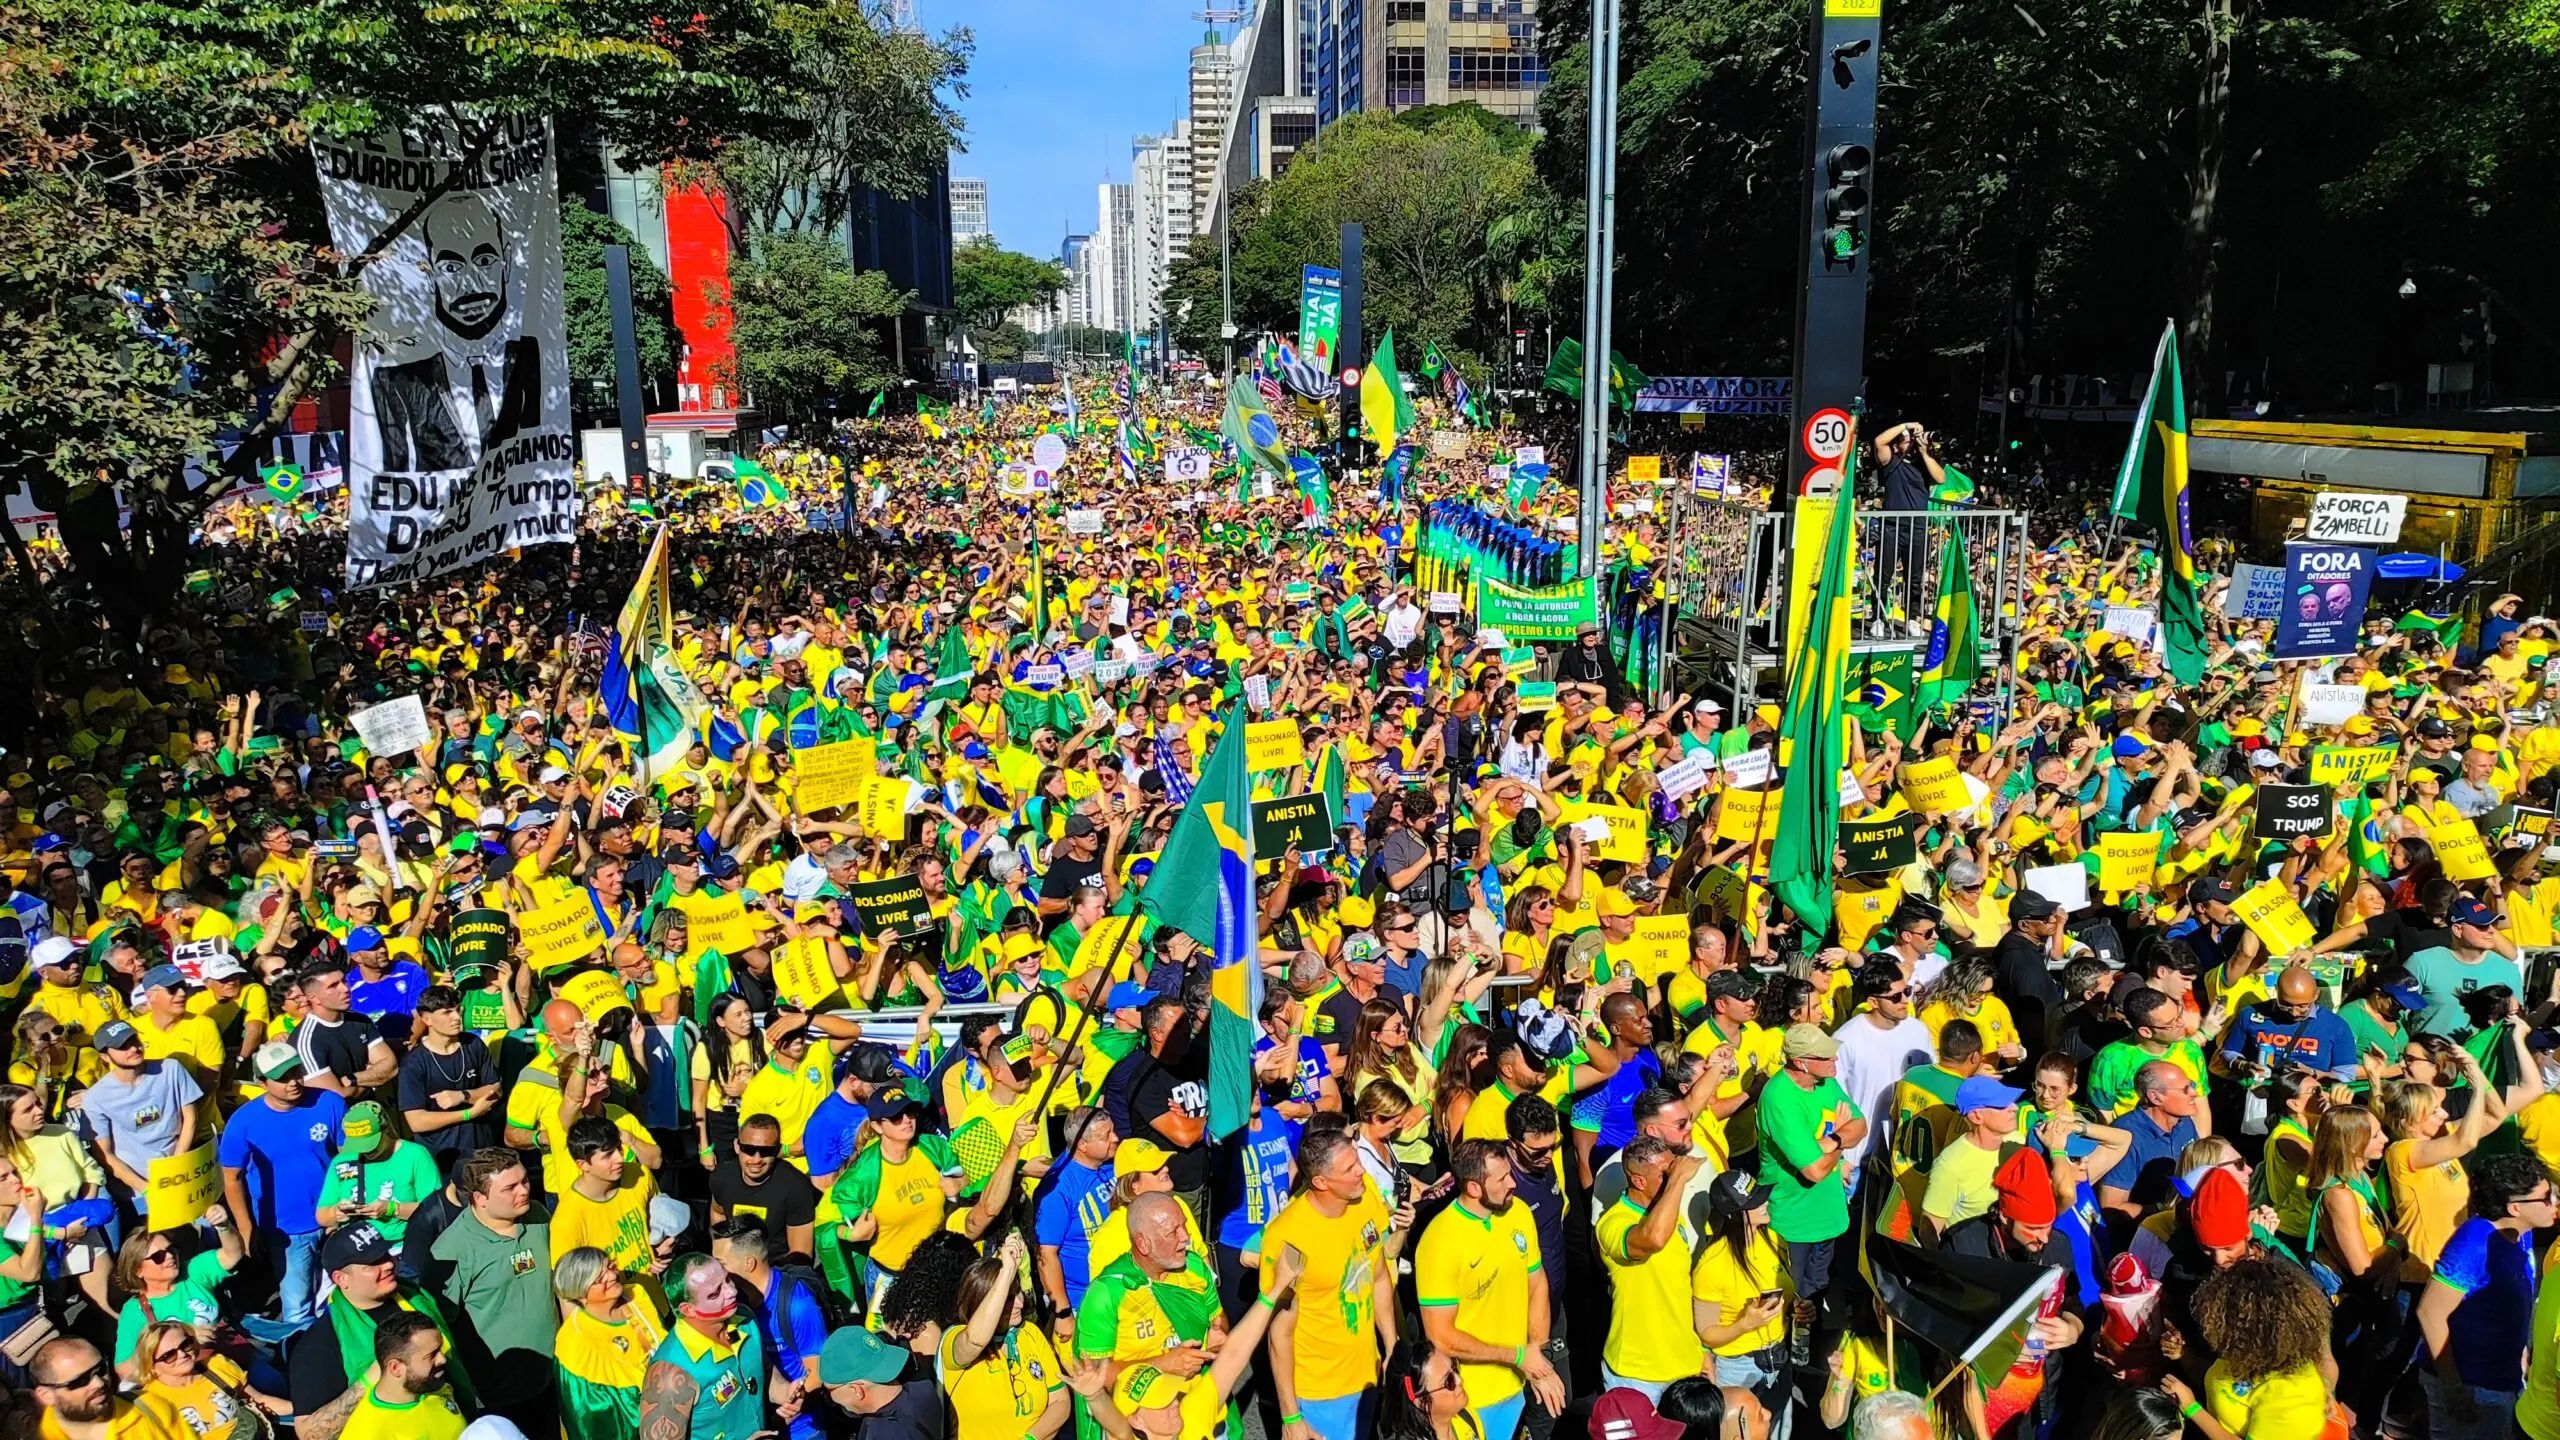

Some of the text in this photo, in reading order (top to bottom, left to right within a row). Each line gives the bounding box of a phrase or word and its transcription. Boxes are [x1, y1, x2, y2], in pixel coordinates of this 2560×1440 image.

[1319, 301, 1338, 328] JÁ
[1303, 295, 1320, 363] NISTIA
[1651, 378, 1709, 397] ORA
[1814, 421, 1846, 444] 50
[1167, 447, 1208, 459] TV LIXO
[486, 477, 572, 515] Trump
[350, 547, 424, 588] Thank
[424, 545, 465, 580] you
[465, 522, 508, 556] very
[514, 504, 576, 540] much
[2299, 552, 2362, 572] FORA
[2306, 572, 2351, 580] DITADORES
[1534, 600, 1579, 610] AUTORIZOU
[1490, 624, 1544, 636] SUPREMO
[1555, 626, 1561, 636] O
[1565, 626, 1578, 636] PO
[1100, 666, 1126, 678] 2026
[2310, 689, 2346, 702] ANISTIA
[1247, 731, 1297, 745] BOLSONARO
[1263, 748, 1285, 757] LIVRE
[2321, 750, 2392, 768] ANISTIA
[1904, 770, 1958, 788] OLSONARO
[1919, 789, 1947, 802] LIVRE
[2287, 794, 2319, 808] SOS
[867, 783, 880, 829] ANISTIA
[884, 798, 896, 812] JÁ
[1266, 803, 1316, 823] ANISTIA
[2273, 817, 2324, 832] TRUMP
[1286, 825, 1303, 843] JÁ
[1853, 825, 1904, 843] ANISTIA
[1871, 847, 1888, 861] JÁ
[2126, 864, 2149, 876] LIVRE
[855, 887, 923, 907] BOLSONARO
[522, 906, 589, 939] BOLSONARO
[875, 910, 909, 926] LIVRE
[546, 933, 580, 952] LIVRE
[697, 931, 725, 943] LIVRE
[1641, 929, 1687, 941] SONARO
[455, 940, 487, 956] LIVRE
[785, 958, 801, 987] LIVRE
[618, 1207, 643, 1234] MEU
[510, 1249, 533, 1264] FORA
[711, 1369, 735, 1396] FORA
